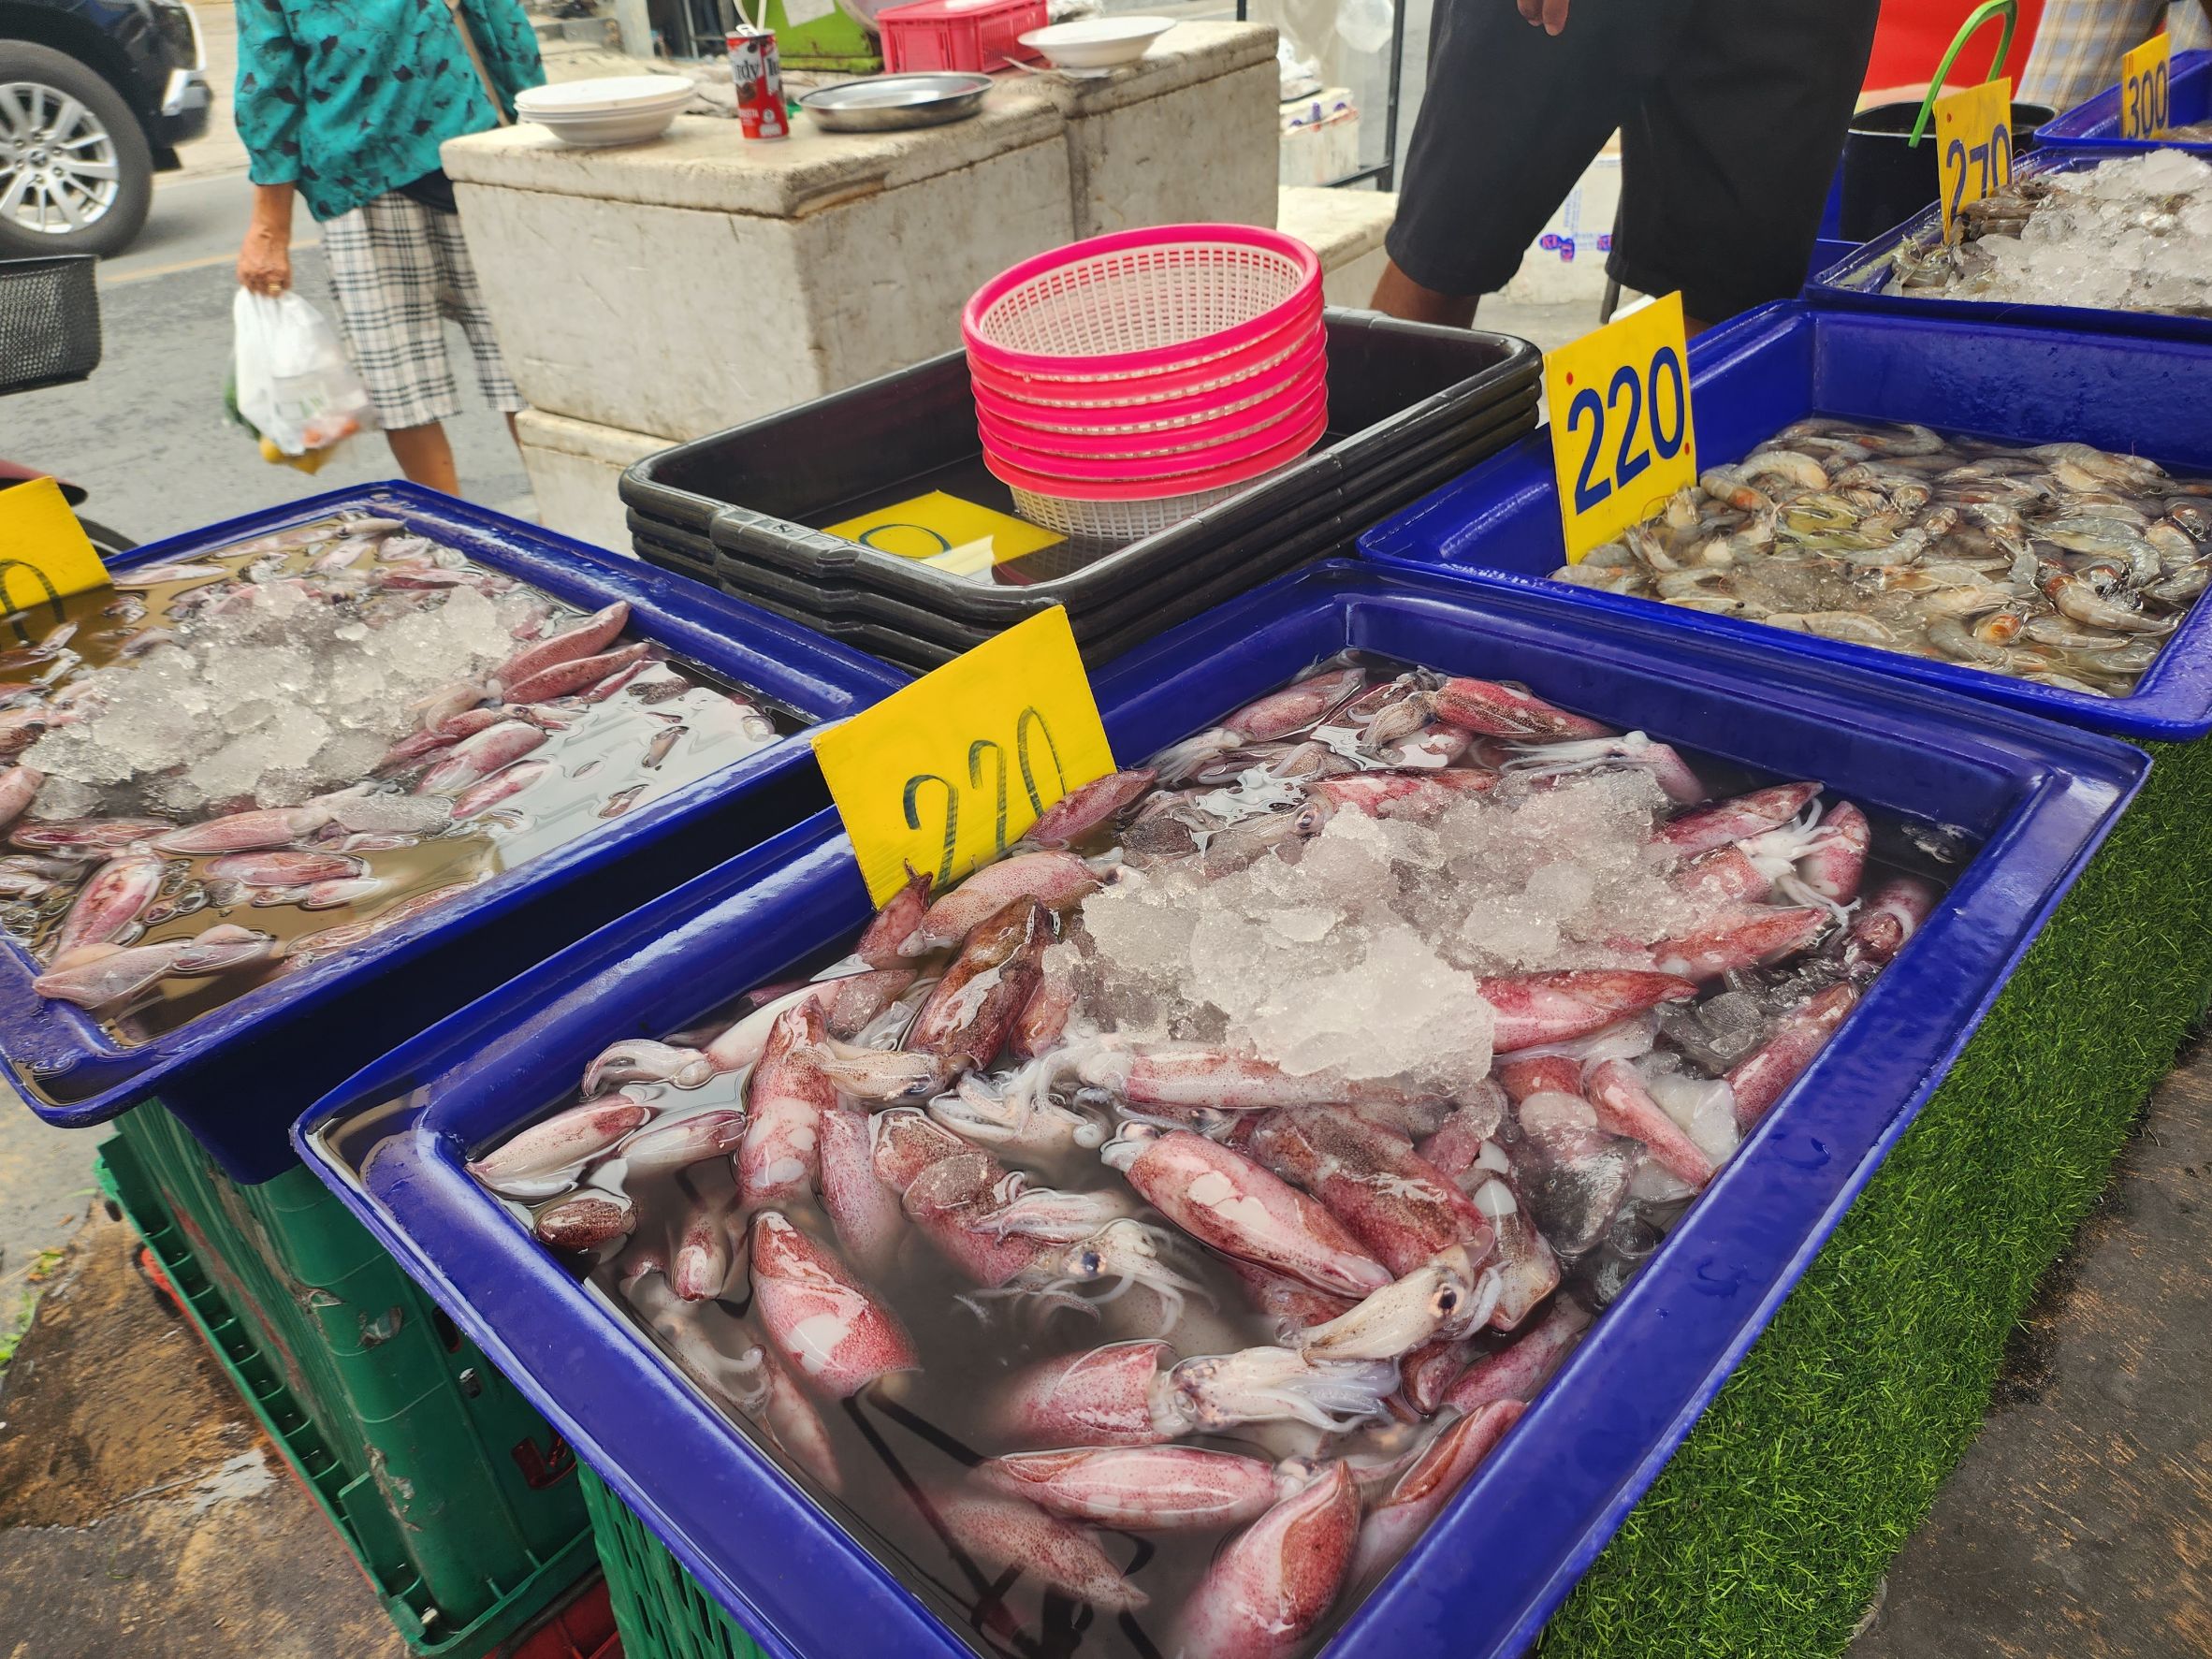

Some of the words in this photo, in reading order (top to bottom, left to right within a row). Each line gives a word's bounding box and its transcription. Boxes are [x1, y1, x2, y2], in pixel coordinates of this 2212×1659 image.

[2127, 60, 2168, 139] 300
[1946, 124, 2012, 226] 270
[1567, 346, 1684, 515] 220
